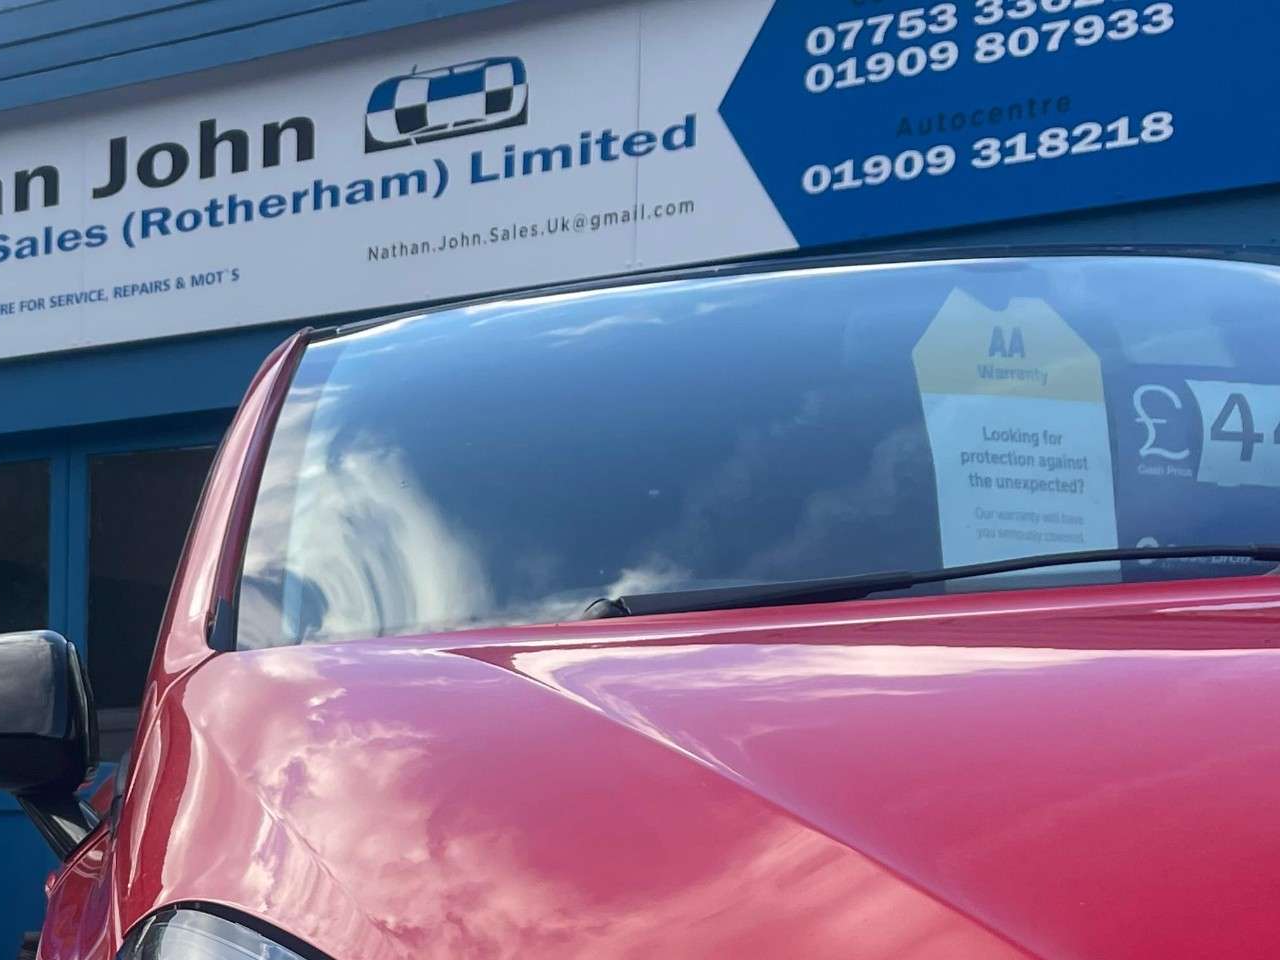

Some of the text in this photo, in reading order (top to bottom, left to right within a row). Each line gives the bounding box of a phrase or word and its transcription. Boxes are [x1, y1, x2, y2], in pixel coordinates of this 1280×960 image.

[805, 2, 958, 56] 07753
[805, 3, 1175, 93] 01909 807933
[896, 95, 1072, 138] Autocentre
[92, 116, 315, 200] John
[802, 110, 1174, 195] 01909 318218
[122, 158, 450, 248] (Rotherham)
[471, 113, 697, 184] Limited
[368, 198, 696, 262] Nathan.John.Sales.Uk@gmail.com
[20, 298, 46, 313] FOR
[49, 288, 109, 309] SERVICE,
[113, 278, 171, 300] REPAIRS
[176, 277, 186, 290] &
[988, 326, 1025, 359] AA
[977, 364, 1049, 386] Warranty
[982, 426, 1063, 447] Looking for
[960, 451, 1088, 471] protection against
[969, 473, 1085, 494] the unexpected?
